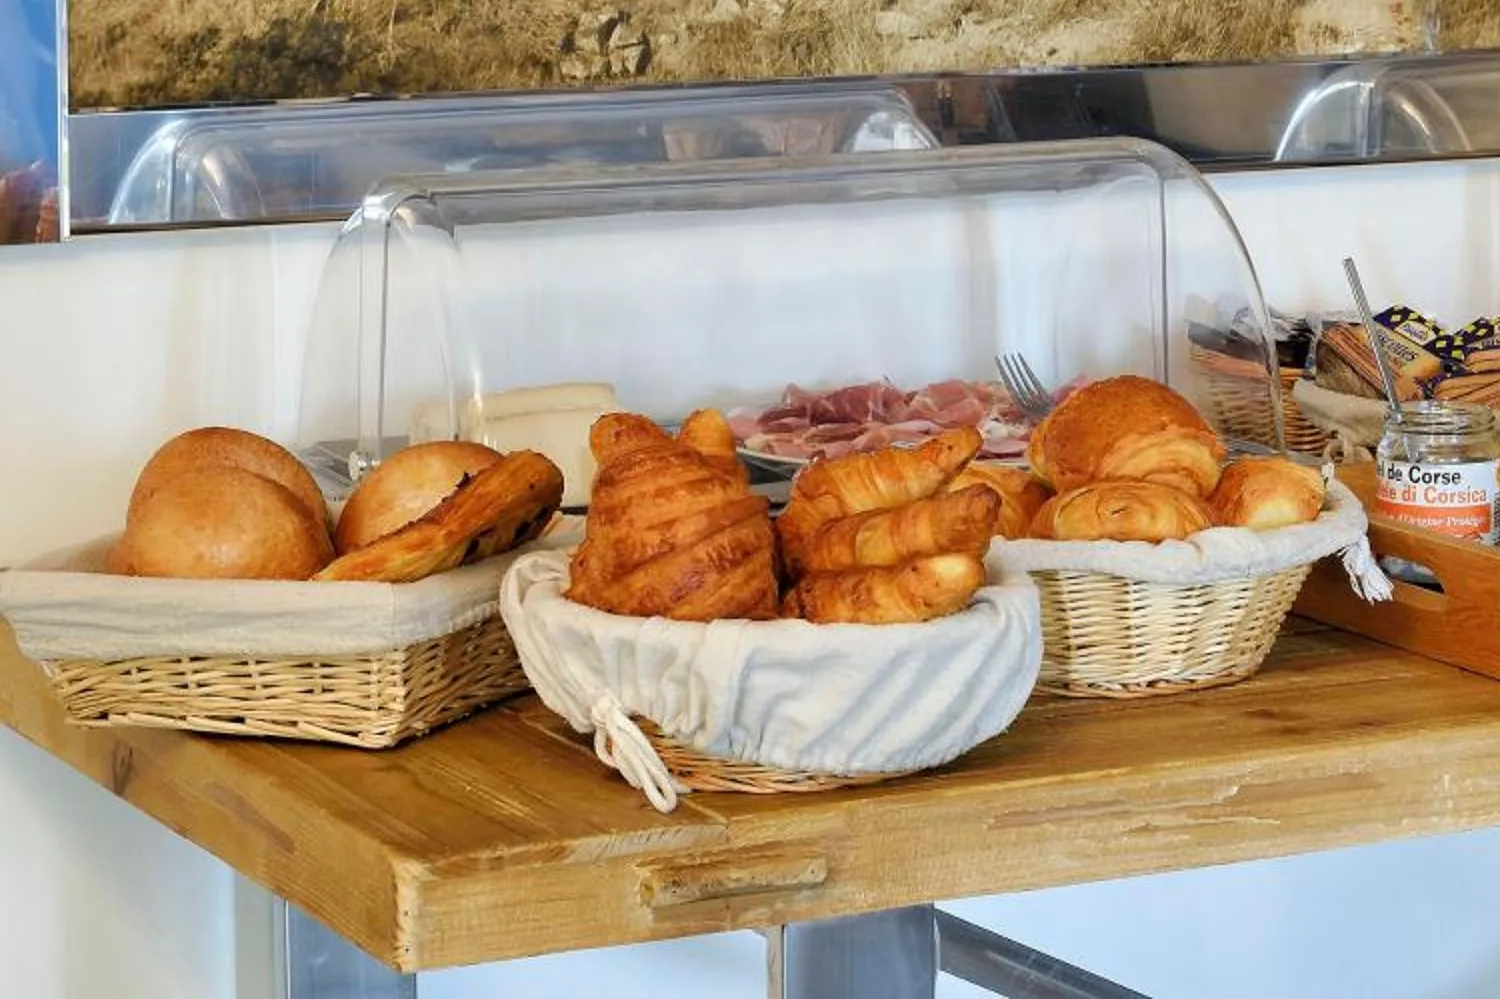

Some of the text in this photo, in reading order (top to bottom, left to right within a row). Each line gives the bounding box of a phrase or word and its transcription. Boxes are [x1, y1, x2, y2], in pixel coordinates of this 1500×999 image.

[1388, 462, 1403, 482] de
[1409, 465, 1462, 485] Corse
[1402, 485, 1416, 502] di
[1423, 485, 1487, 504] Corsica
